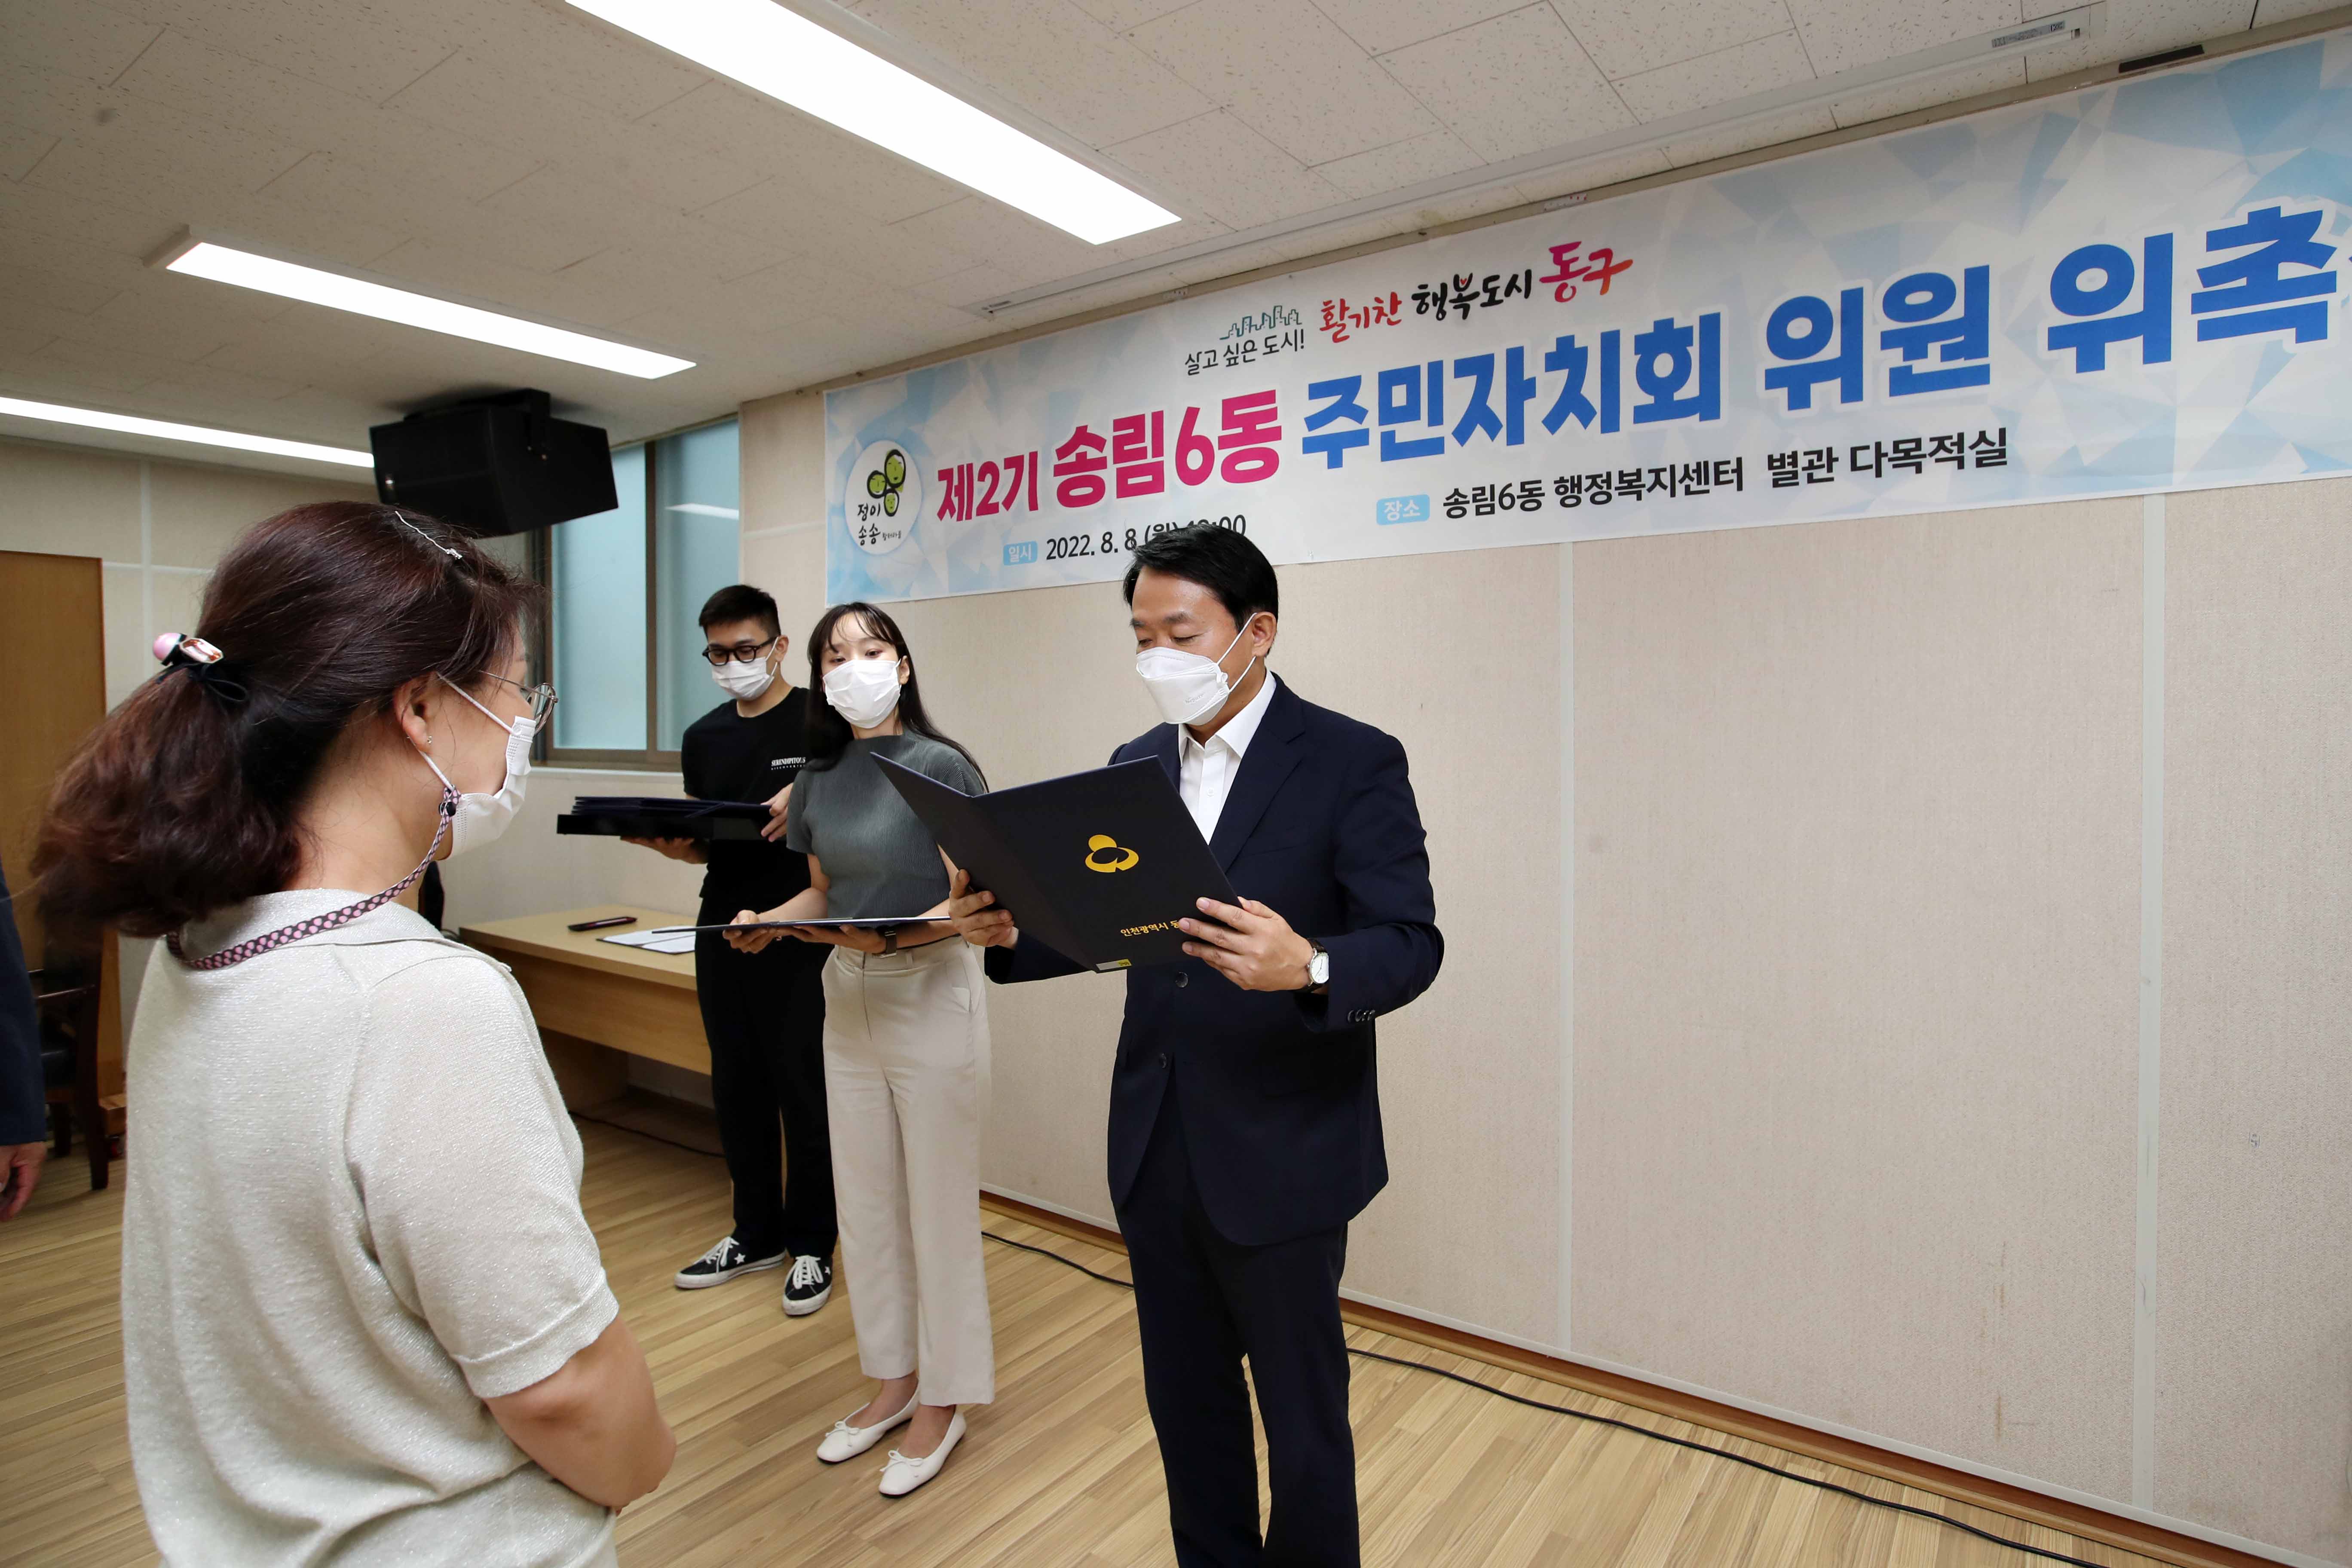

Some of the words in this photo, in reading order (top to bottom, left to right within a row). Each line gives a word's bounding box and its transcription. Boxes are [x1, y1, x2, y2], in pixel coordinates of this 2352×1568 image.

[1319, 291, 1403, 343] 활기찬
[1411, 269, 1532, 321] 행복도시
[1539, 241, 1634, 303] 동구
[937, 450, 1039, 522] 제2기
[1052, 389, 1283, 508] 송림6동
[1302, 311, 1721, 469] 주민자치회
[1764, 264, 1991, 411] 위원
[2048, 205, 2352, 374] 위촉
[1185, 349, 1219, 376] 살고
[1223, 340, 1258, 367] 싶은
[1262, 328, 1305, 355] 도시!
[1383, 500, 1421, 522] 장소
[1442, 479, 1546, 519] 송림6동
[1553, 456, 1744, 509] 행정복지센터
[1767, 446, 1839, 488] 별관
[1850, 427, 2008, 479] 다목적실
[858, 502, 881, 522] 정이
[858, 523, 881, 546] 송송
[1008, 544, 1032, 562] 일시
[1046, 534, 1095, 560] 2022.
[1100, 531, 1118, 554] 8.
[1120, 922, 1170, 937] 인천광역시
